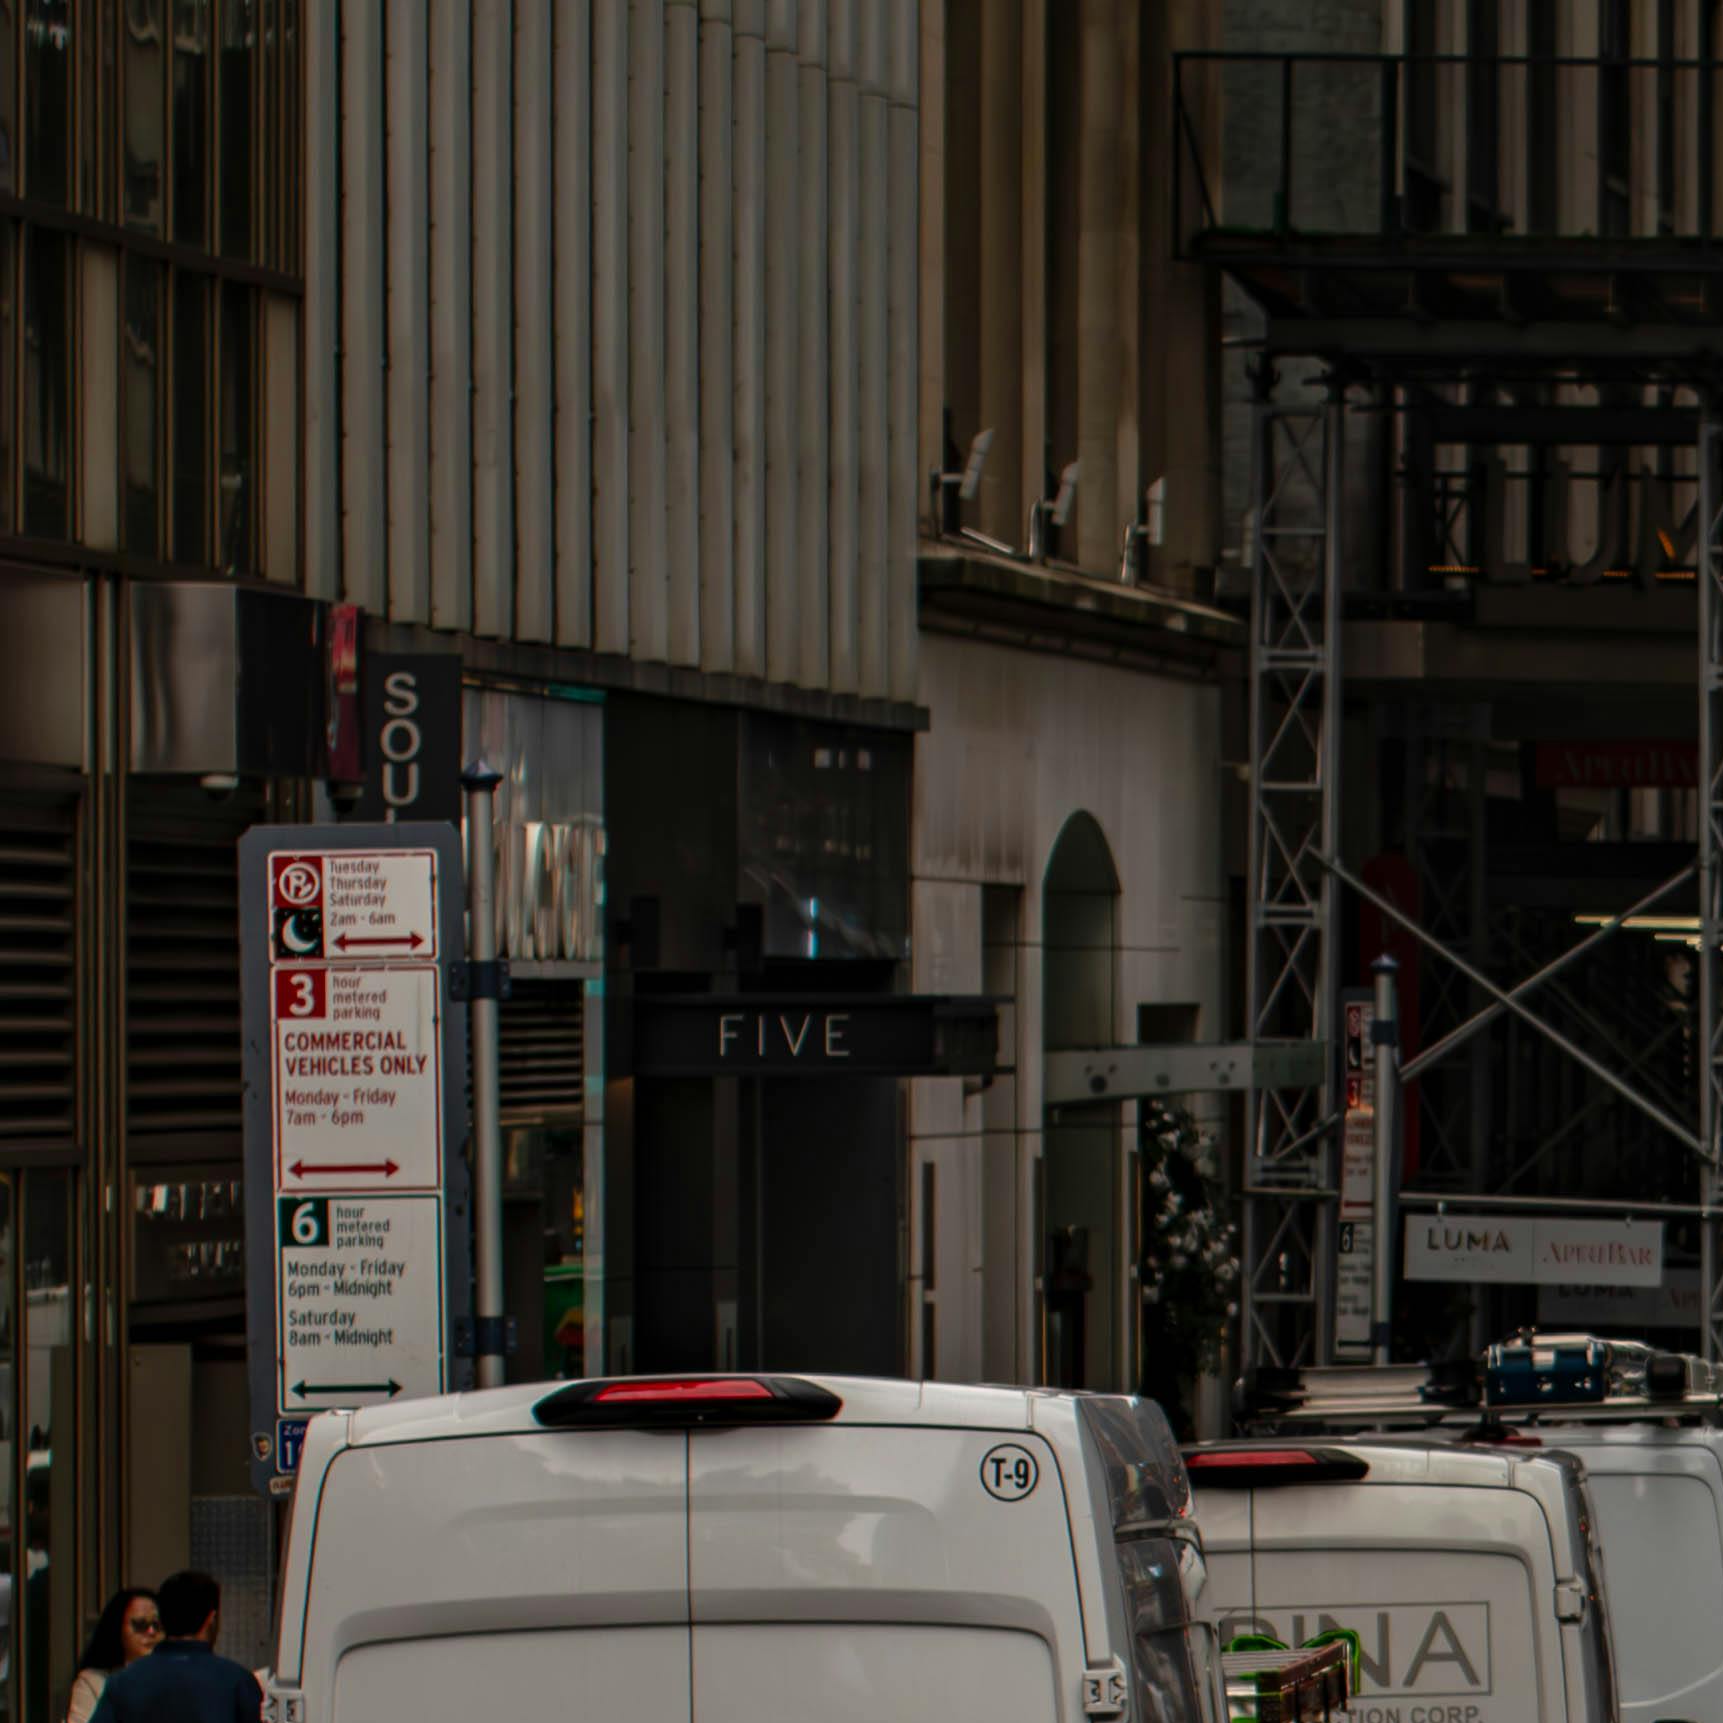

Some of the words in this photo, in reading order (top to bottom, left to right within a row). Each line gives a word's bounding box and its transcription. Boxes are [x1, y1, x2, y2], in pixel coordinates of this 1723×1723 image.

[380, 671, 421, 824] SOU
[330, 860, 380, 875] Tuesday
[330, 876, 387, 892] Thursday
[329, 893, 386, 908] Saturday
[329, 912, 356, 926] 2am
[368, 912, 396, 926] 6am
[332, 975, 362, 988] hour
[288, 972, 315, 1017] 3
[332, 989, 388, 1004] metered
[332, 1005, 381, 1021] parking
[284, 1031, 407, 1051] COMMERCIAL
[719, 1014, 851, 1058] FIVE
[285, 1054, 375, 1077] VEHICLES
[380, 1054, 428, 1076] ONLY
[285, 1088, 340, 1106] Monday
[352, 1088, 397, 1107] Friday
[286, 1109, 316, 1126] 7am
[331, 1109, 364, 1128] 6pm
[336, 1205, 365, 1219] hour
[291, 1201, 319, 1245] 6
[336, 1219, 391, 1233] metered
[336, 1233, 384, 1249] parking
[1426, 1227, 1512, 1253] LUMA
[287, 1260, 345, 1279] Monday
[360, 1260, 405, 1278] Friday
[287, 1281, 320, 1299] 6pm
[333, 1280, 393, 1299] Midnight
[288, 1309, 356, 1328] Saturday
[288, 1330, 321, 1347] 8am
[334, 1329, 394, 1348] Midnight
[989, 1456, 1030, 1491] T-9
